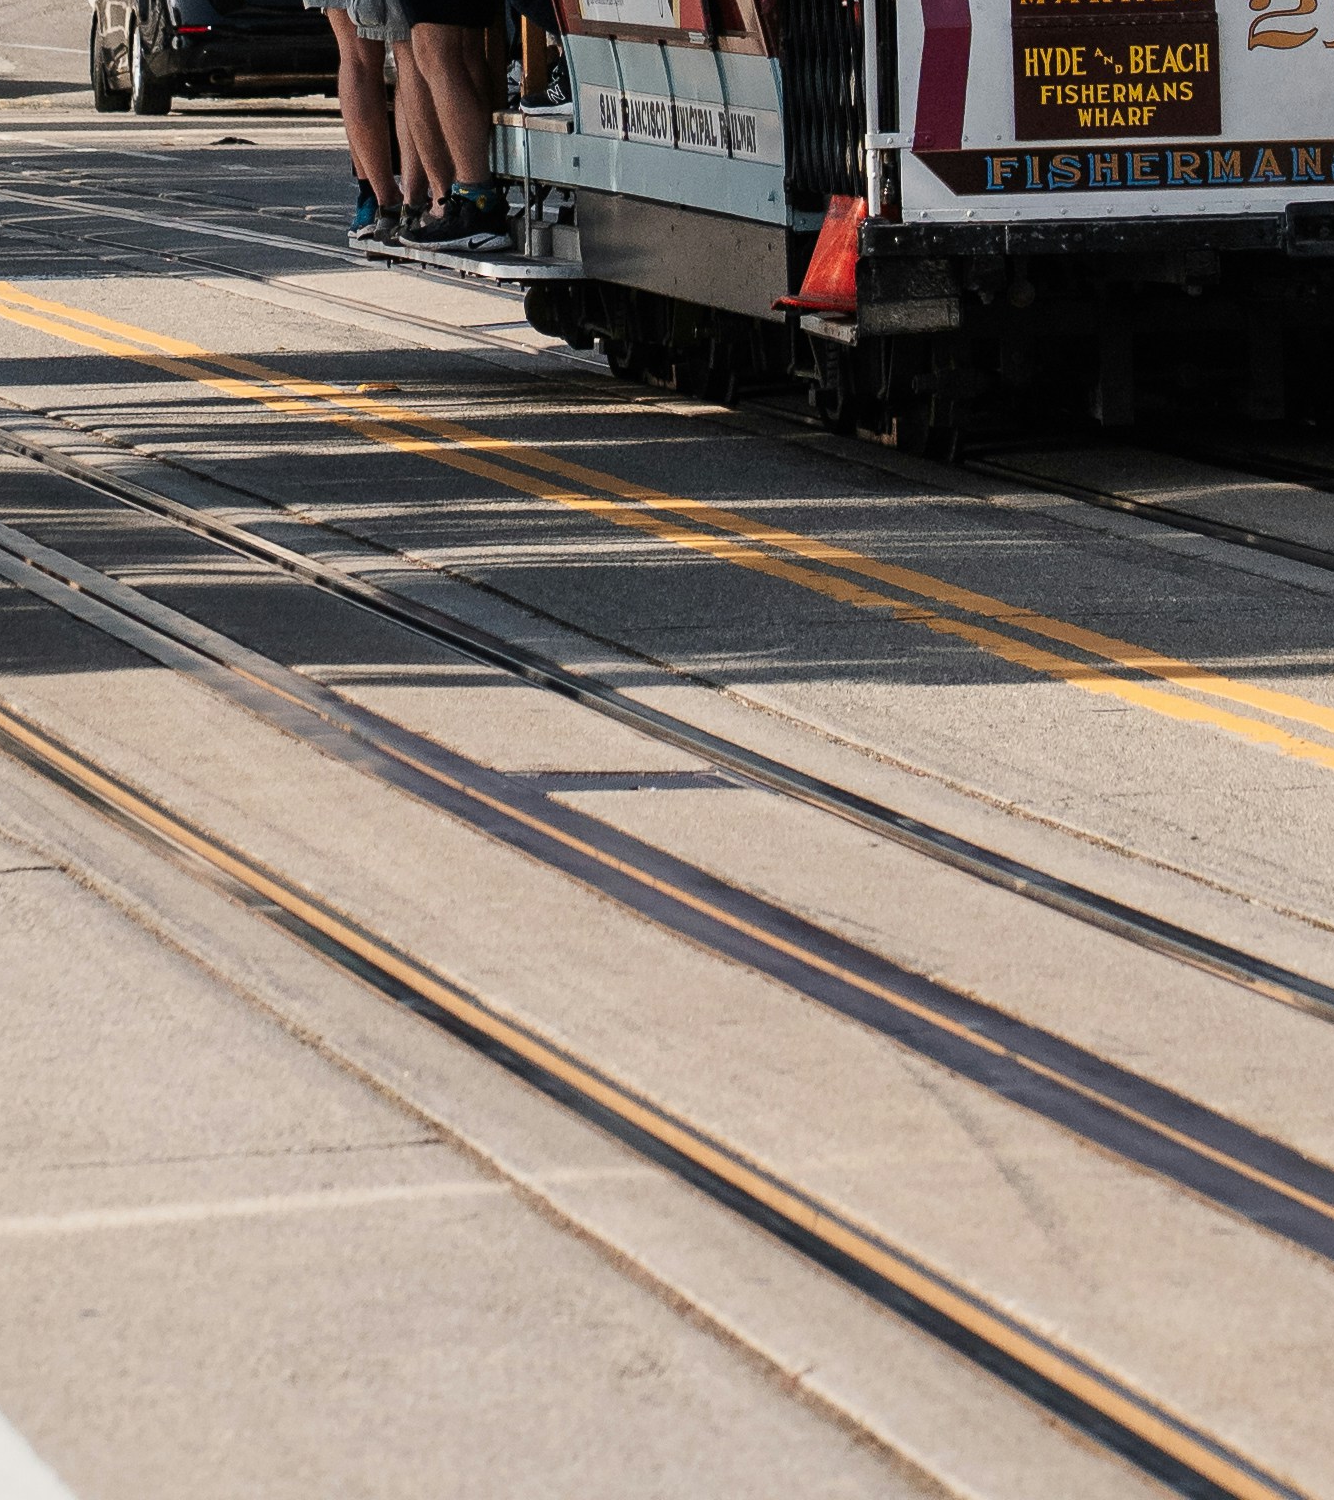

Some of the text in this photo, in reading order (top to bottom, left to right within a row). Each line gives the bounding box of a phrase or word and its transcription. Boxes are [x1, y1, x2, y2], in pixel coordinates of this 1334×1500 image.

[1024, 43, 1210, 77] HYDE AND BEACH
[1040, 81, 1193, 106] FISHERMANS
[600, 93, 619, 130] SAN
[621, 97, 668, 140] RANCISCO
[668, 104, 718, 148] UNICIPAL
[1078, 106, 1157, 128] WHARF
